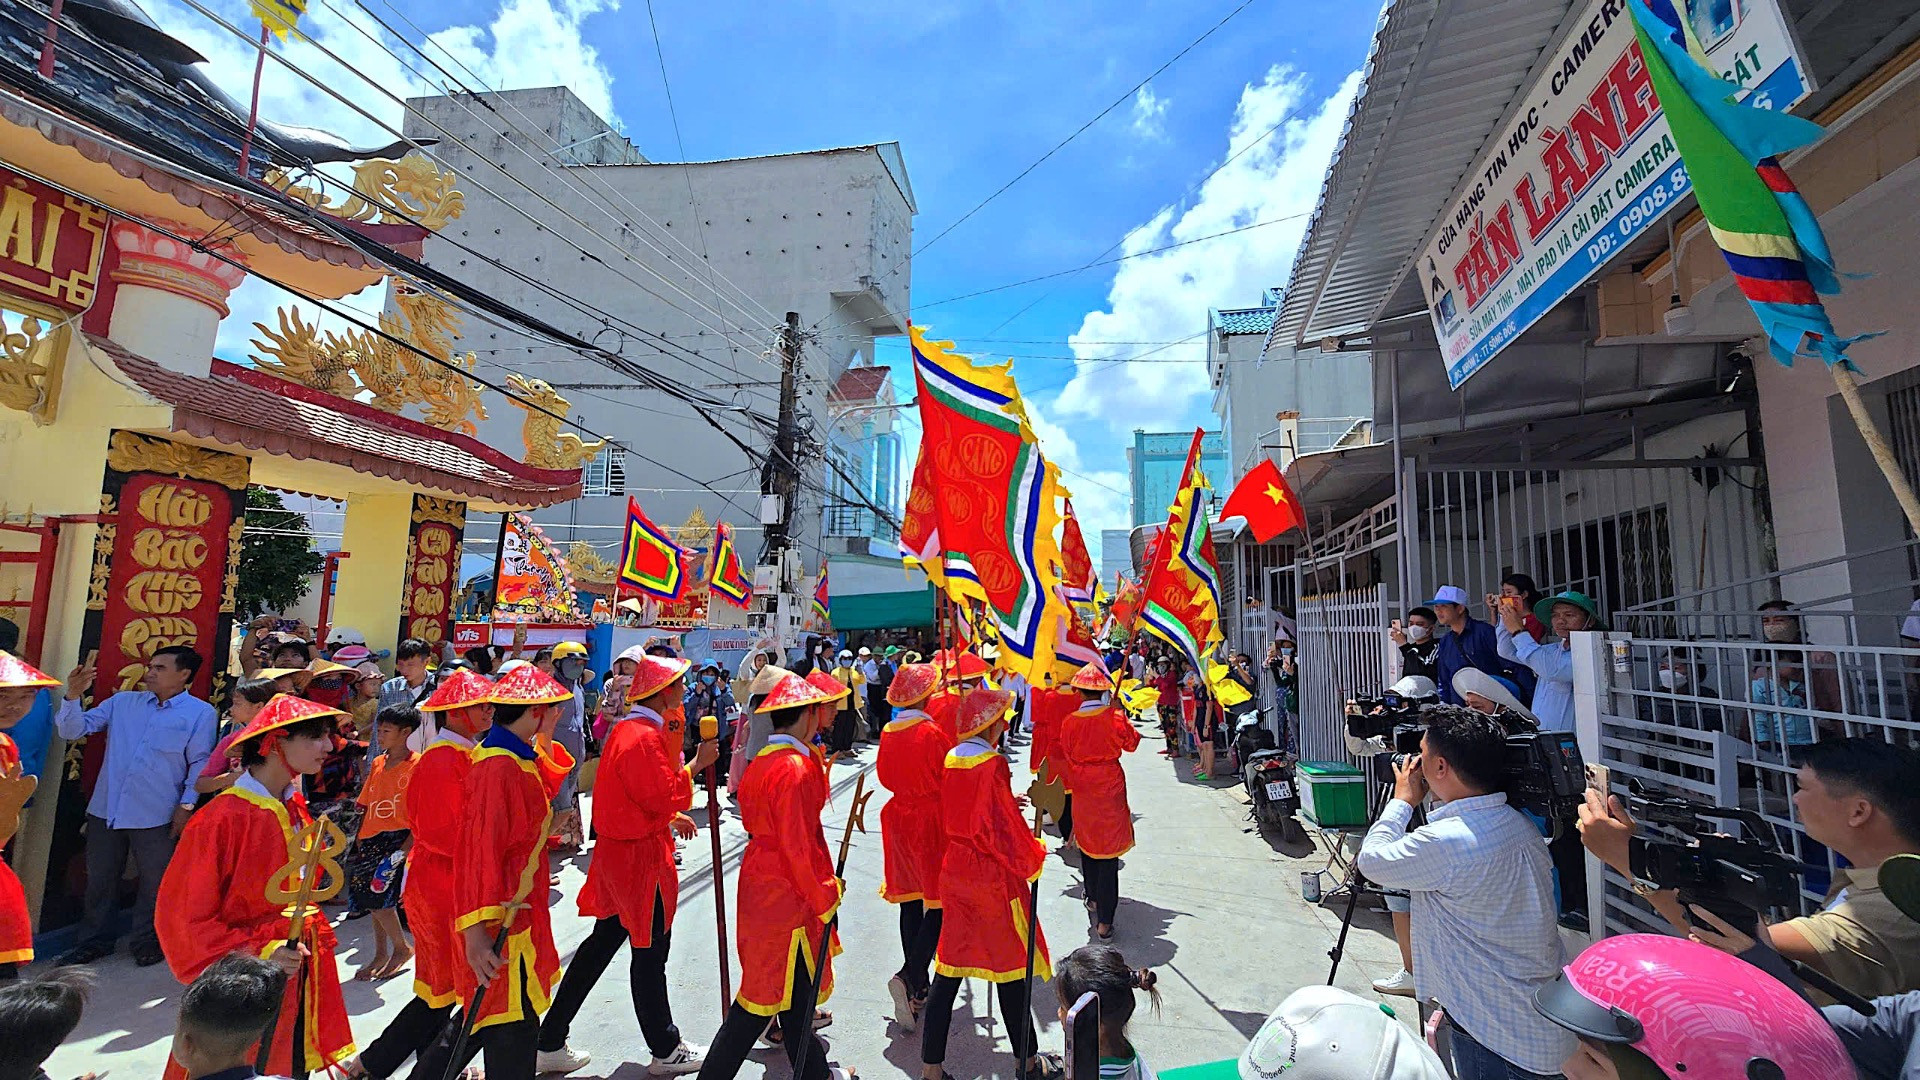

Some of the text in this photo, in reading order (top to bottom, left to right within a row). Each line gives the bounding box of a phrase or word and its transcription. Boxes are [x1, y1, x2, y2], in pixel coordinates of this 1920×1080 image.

[1438, 223, 1458, 255] CỬA
[1456, 182, 1486, 228] HÀNG
[1485, 155, 1509, 189] TIN
[1507, 105, 1539, 158] HỌC
[1482, 306, 1498, 330] MÁY
[1498, 288, 1515, 315] TÍNH
[1516, 269, 1537, 297] MÁY
[1535, 246, 1558, 278] IPAD
[1556, 229, 1573, 256] VÀ
[1571, 211, 1592, 243] CÀI
[1590, 188, 1615, 225] ĐẶT
[1615, 133, 1676, 200] CAMERA
[1618, 163, 1692, 237] 0908.8
[1453, 201, 1525, 314] TẤN
